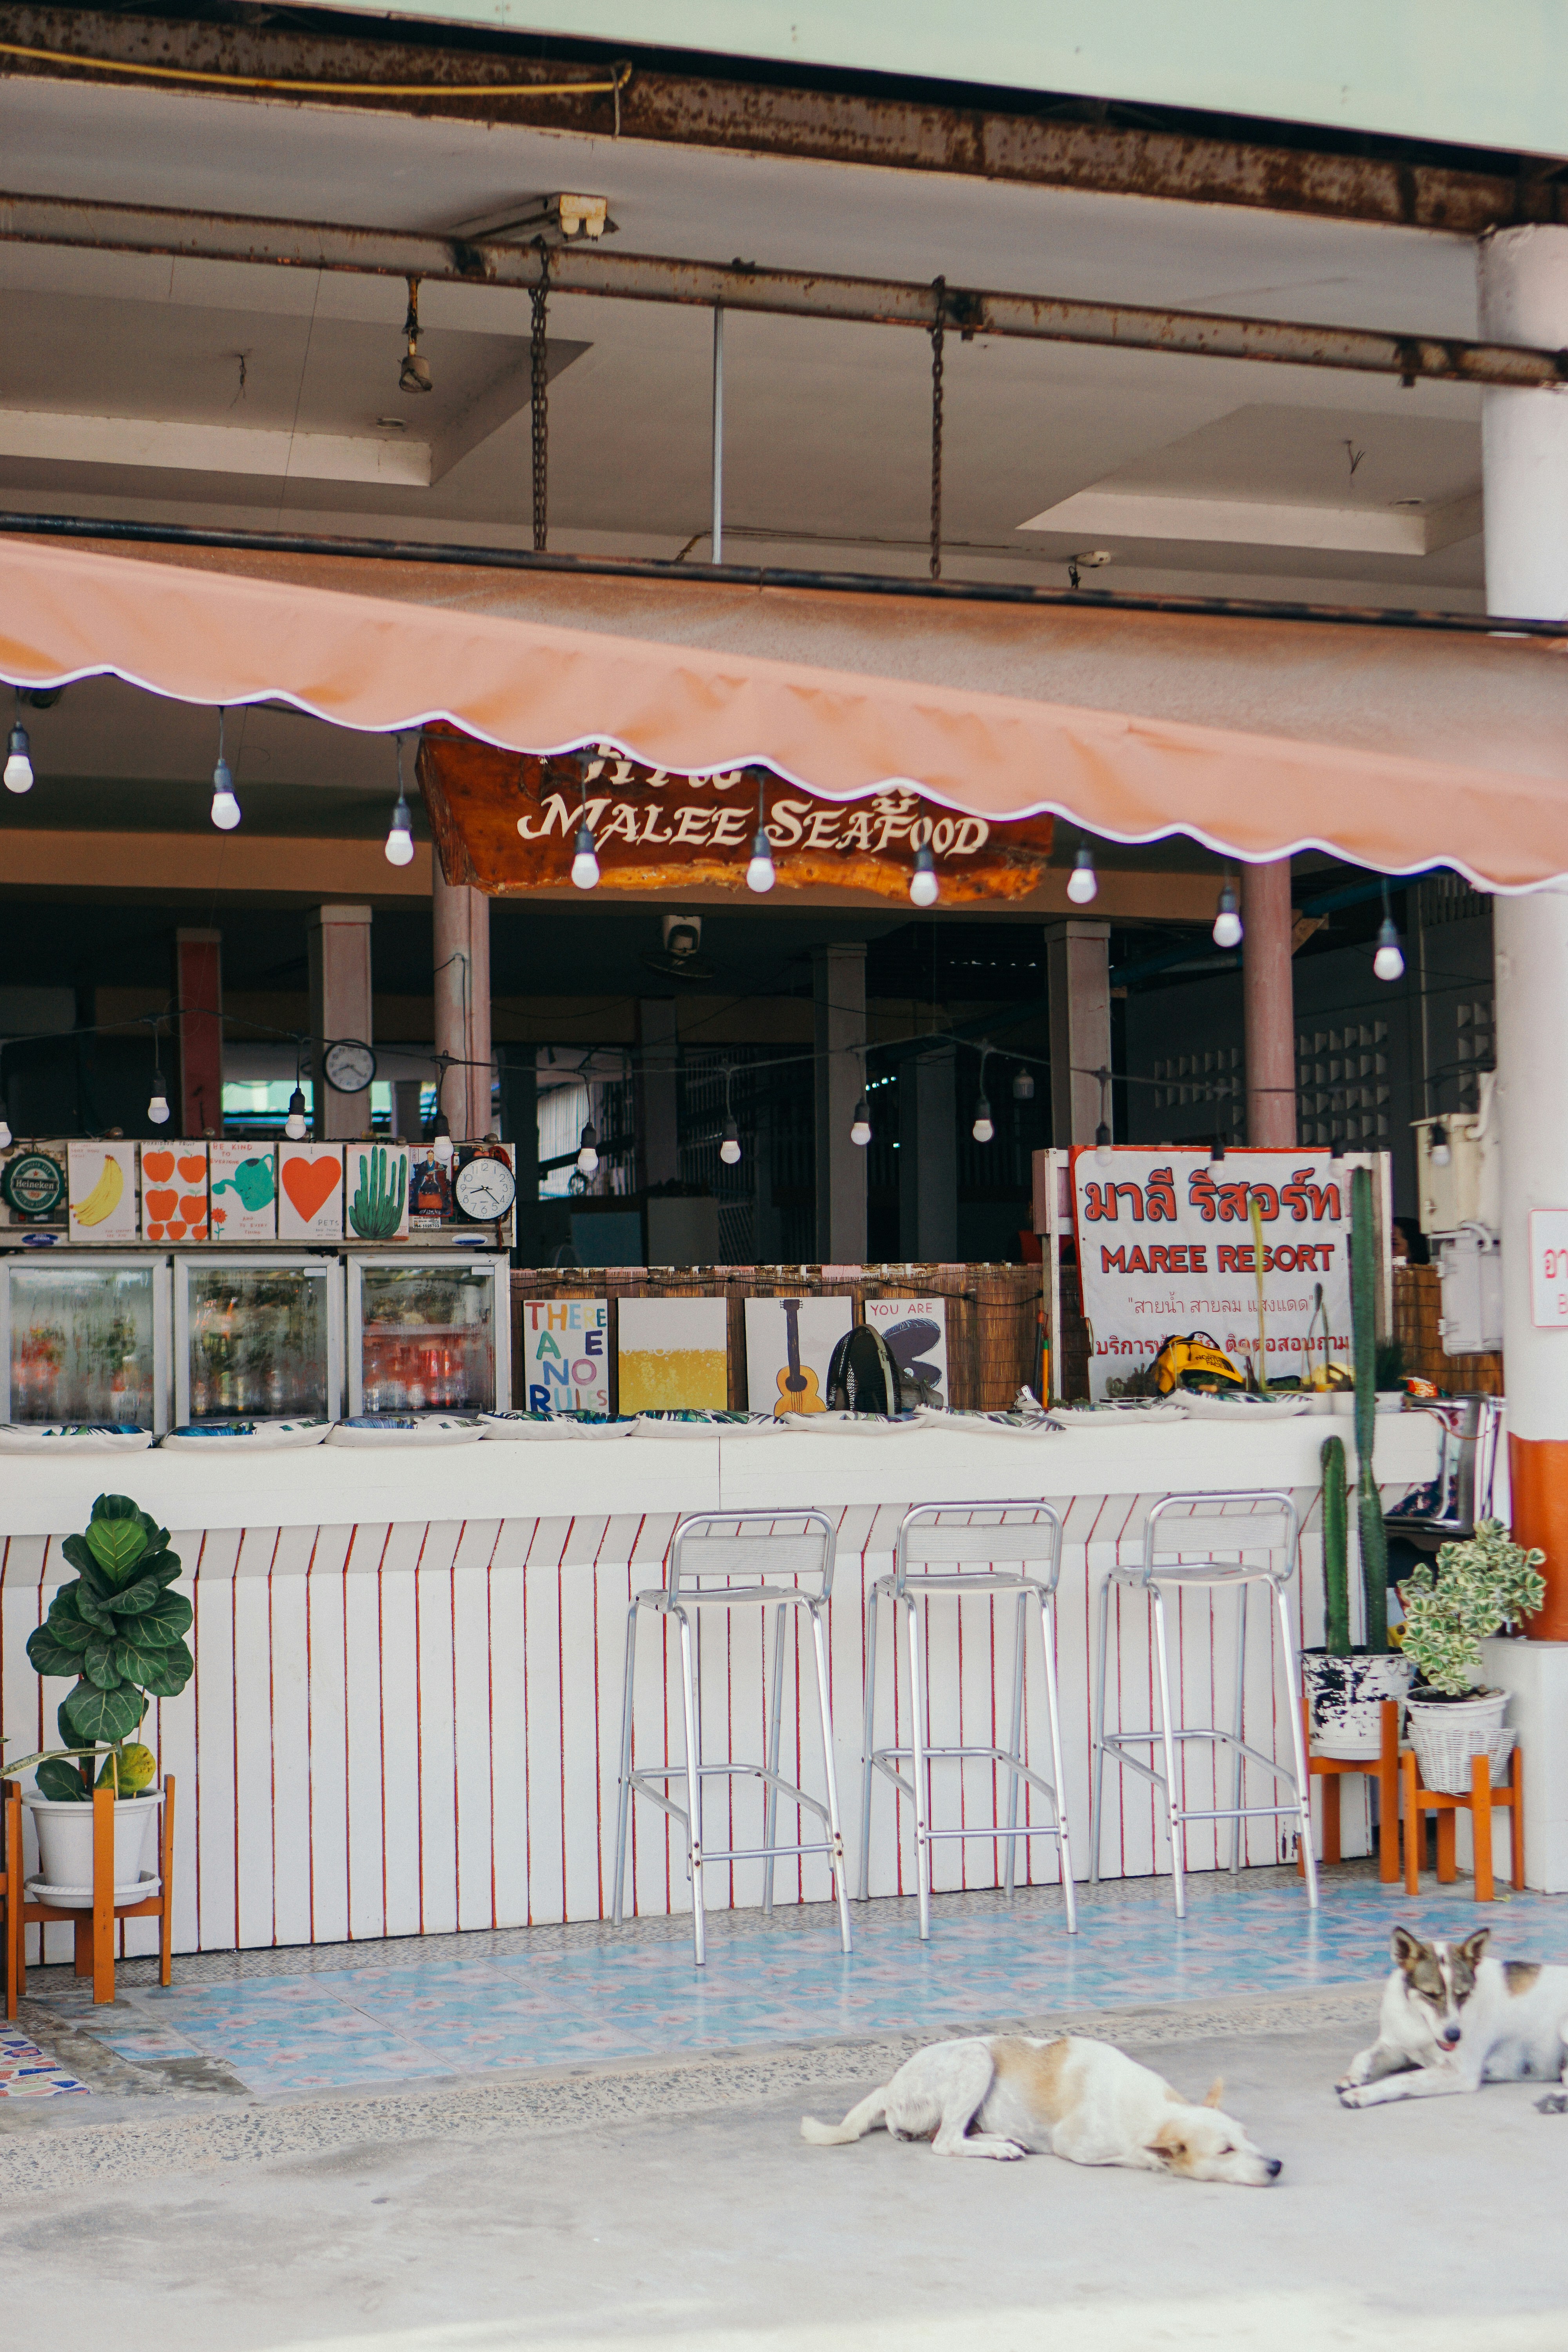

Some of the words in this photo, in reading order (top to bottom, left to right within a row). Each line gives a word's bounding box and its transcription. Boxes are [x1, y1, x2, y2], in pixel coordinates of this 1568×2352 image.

[517, 793, 753, 852] MALEE
[764, 800, 989, 860] SEAFOOD
[472, 1166, 478, 1174] 11
[481, 1163, 488, 1171] 12
[464, 1174, 472, 1182] 10
[499, 1174, 505, 1182] 2
[16, 1179, 54, 1189] Heineken
[460, 1184, 466, 1192] 9
[502, 1183, 508, 1192] 3
[1085, 1167, 1177, 1221] มาลี
[463, 1195, 469, 1203] 8
[471, 1202, 477, 1211] 7
[481, 1205, 487, 1214] 6
[492, 1202, 498, 1211] 5
[1100, 1245, 1208, 1274] MAREE
[1217, 1244, 1335, 1274] RESORT
[870, 1304, 898, 1316] YOU
[907, 1303, 933, 1313] ARE
[1190, 1298, 1241, 1313] สายลม
[525, 1302, 607, 1330] THERE
[1206, 1360, 1223, 1368] FACE
[543, 1359, 597, 1385] NO
[529, 1384, 607, 1412] RULES
